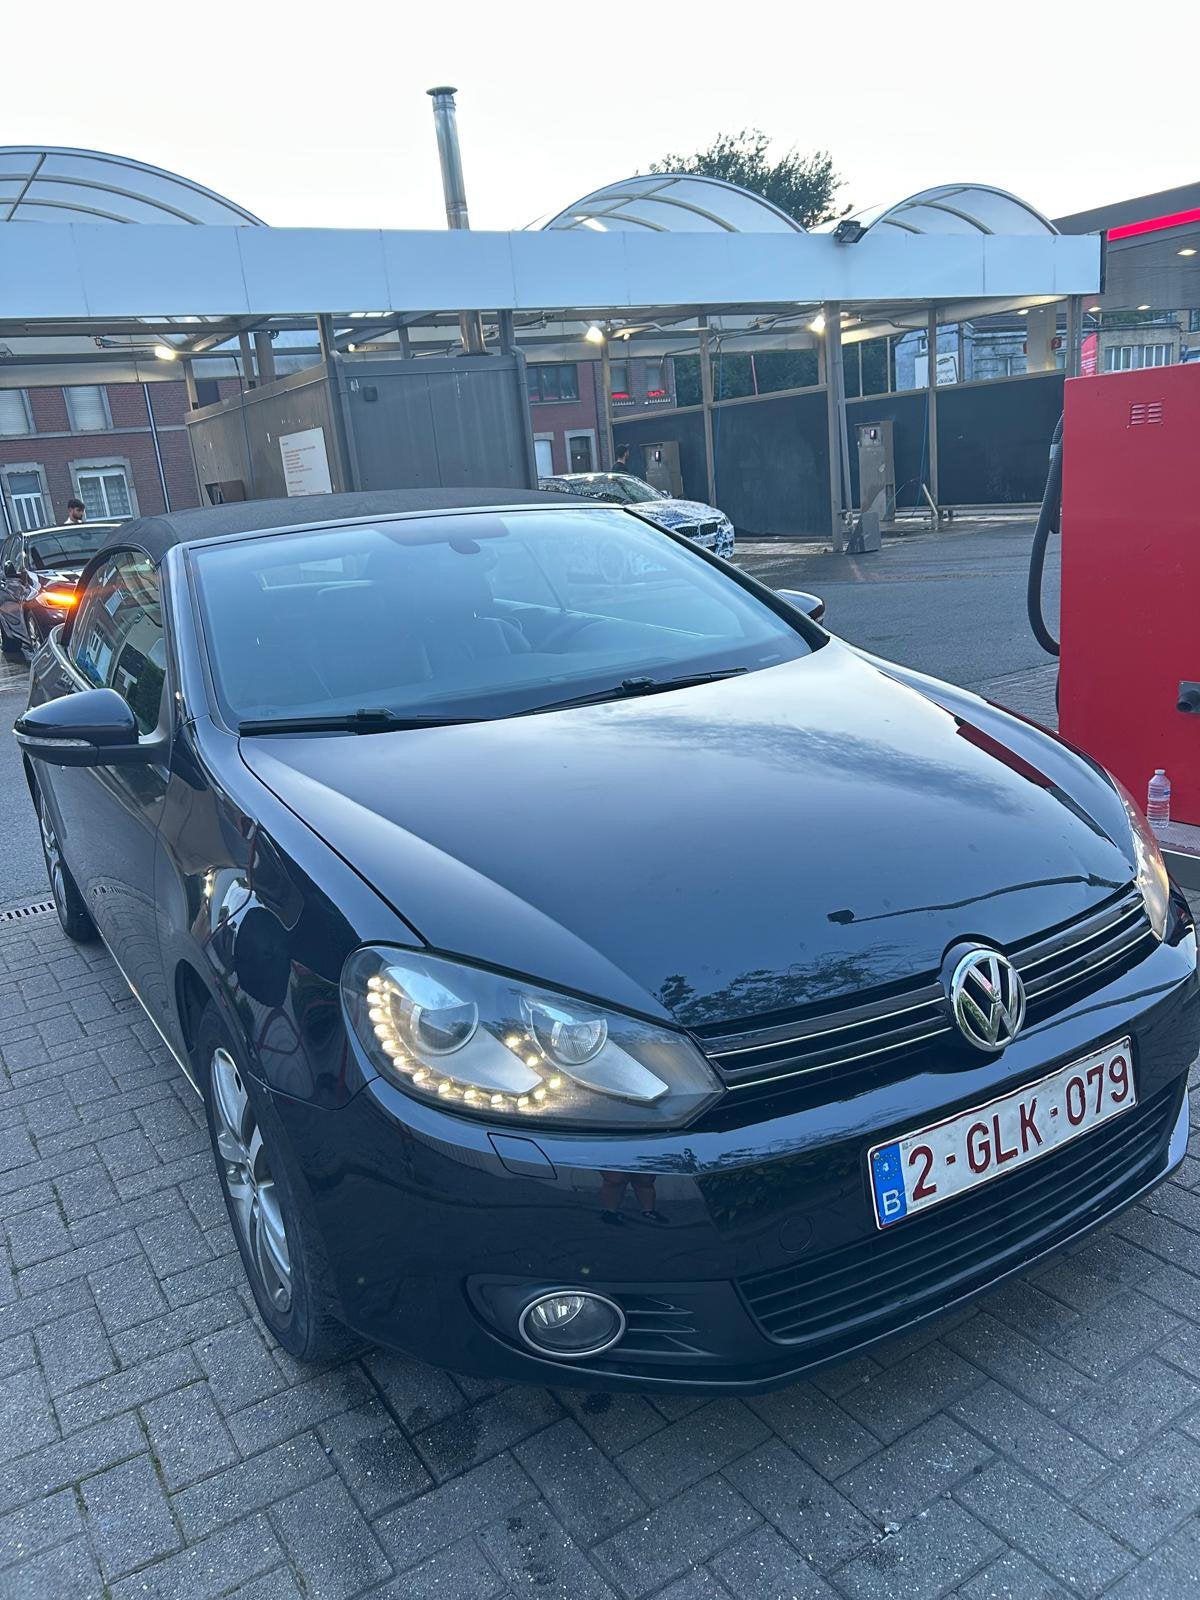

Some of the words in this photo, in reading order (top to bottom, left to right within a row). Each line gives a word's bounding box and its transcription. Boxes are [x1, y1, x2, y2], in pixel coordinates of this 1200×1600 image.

[953, 952, 1025, 1050] VW
[908, 1055, 1129, 1202] 2-GLK-079
[882, 1189, 901, 1216] B
